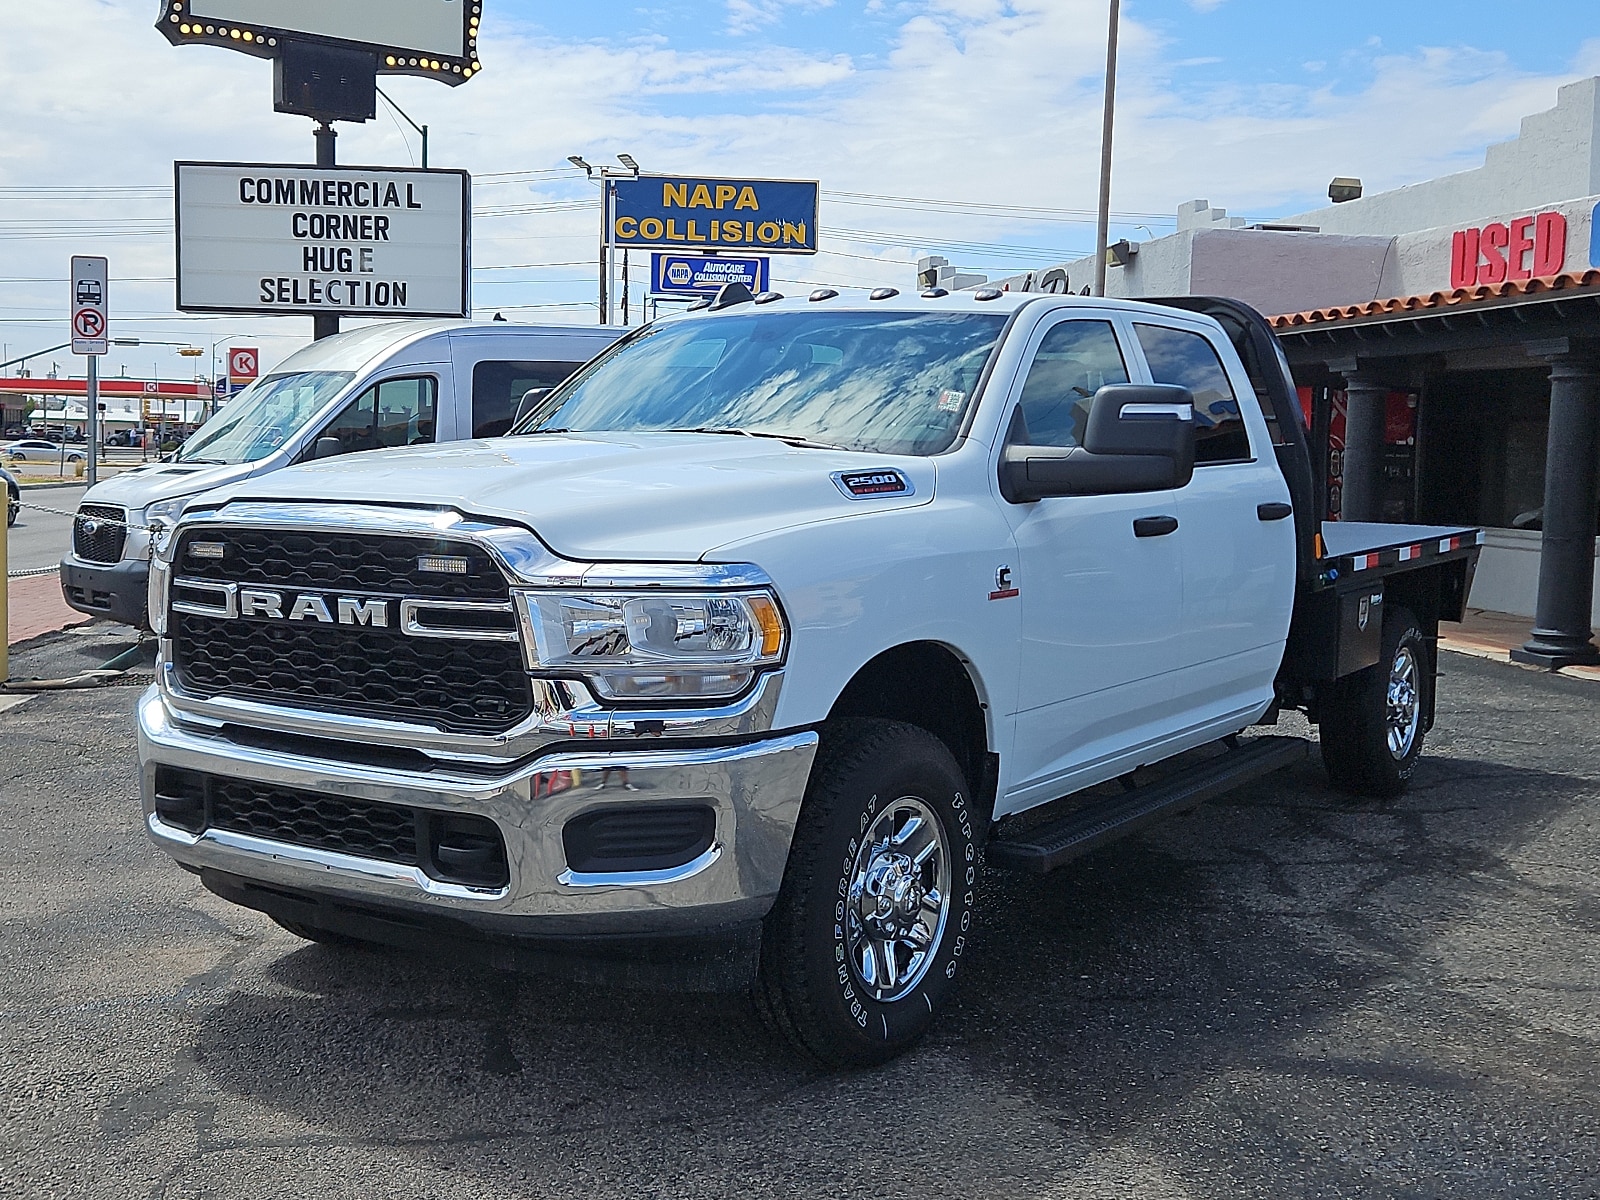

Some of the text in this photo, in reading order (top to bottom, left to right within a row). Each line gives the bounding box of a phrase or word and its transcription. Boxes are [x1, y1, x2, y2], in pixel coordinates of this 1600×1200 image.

[239, 177, 422, 209] COMMERCIAL
[663, 182, 759, 211] NAPA
[292, 212, 390, 241] CORNER
[615, 216, 806, 244] COLLISION
[303, 246, 374, 273] HUGE
[1451, 210, 1568, 290] USED
[671, 268, 689, 279] NAPA
[259, 277, 408, 307] SELECTION
[846, 474, 897, 487] 2500
[240, 588, 389, 628] RAM
[834, 794, 878, 1028] TRANSFORCE AT
